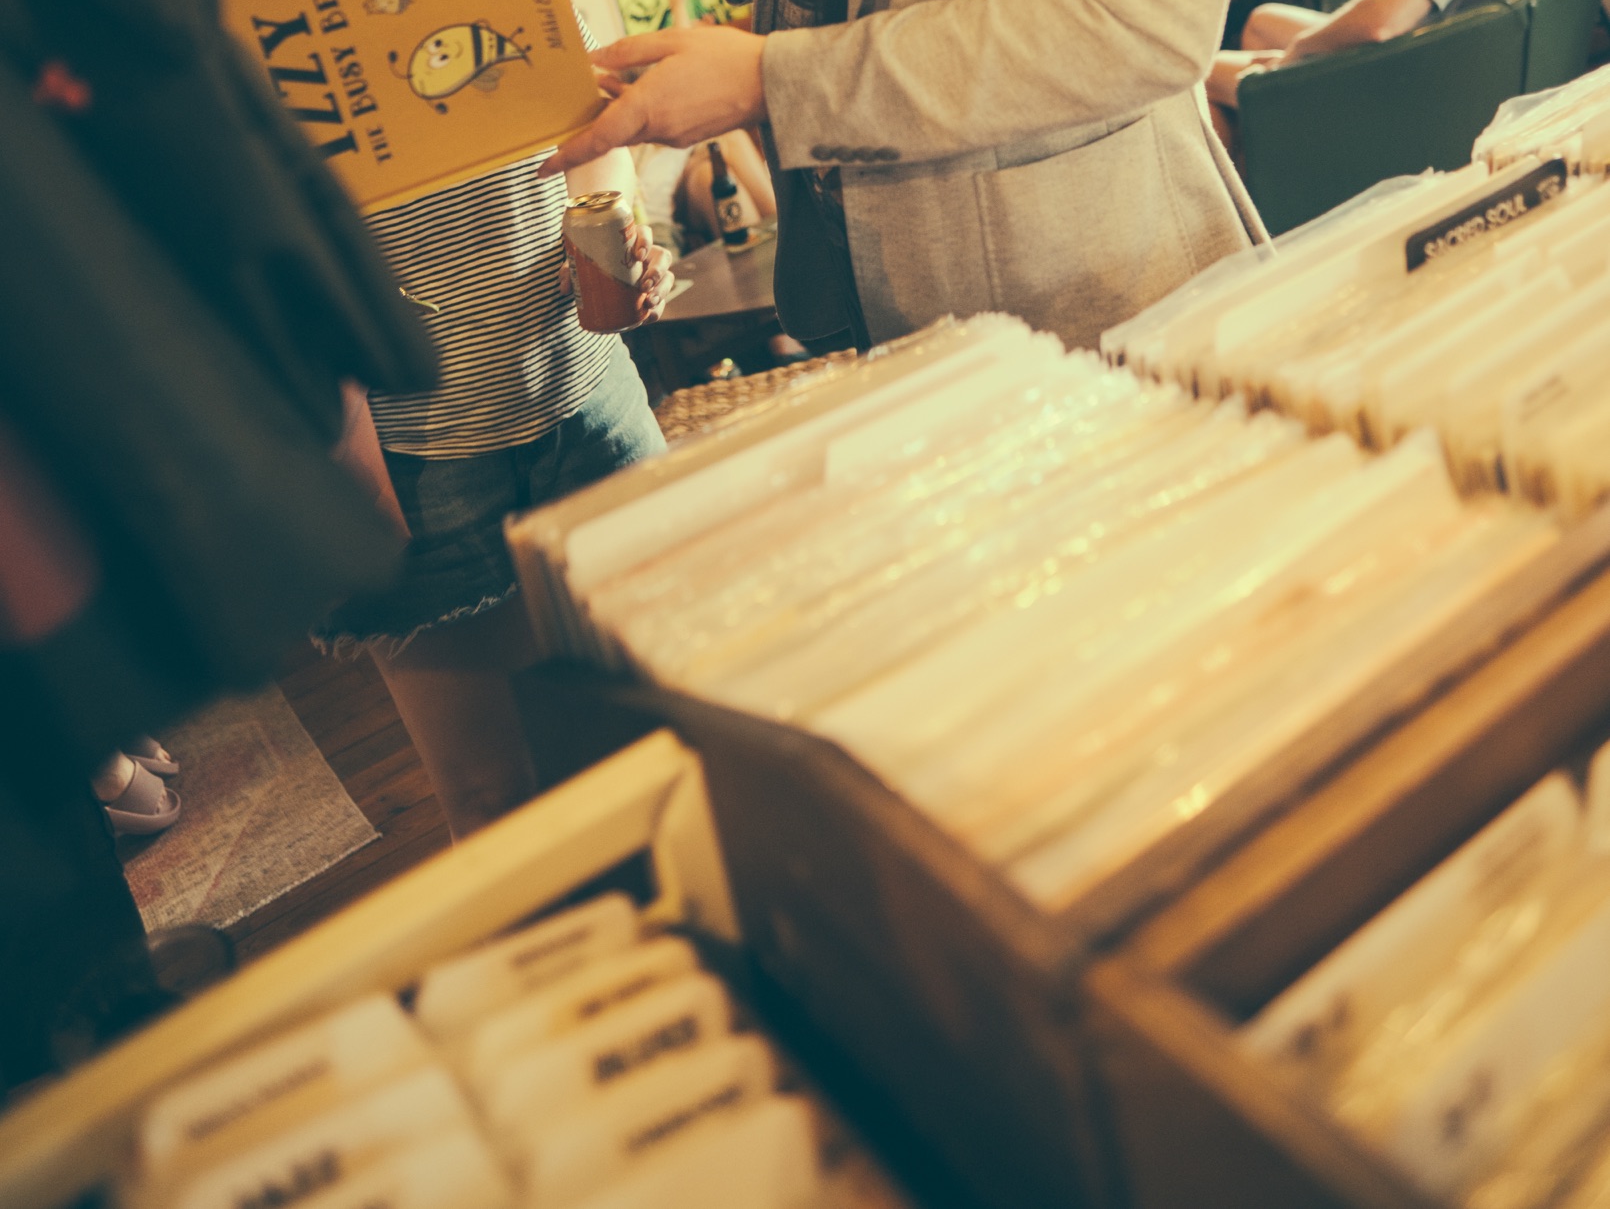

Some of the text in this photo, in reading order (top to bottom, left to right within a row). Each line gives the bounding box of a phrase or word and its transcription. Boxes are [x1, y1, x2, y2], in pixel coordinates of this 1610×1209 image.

[252, 12, 360, 162] IZZY
[330, 45, 378, 118] BUSY
[366, 125, 393, 166] THE
